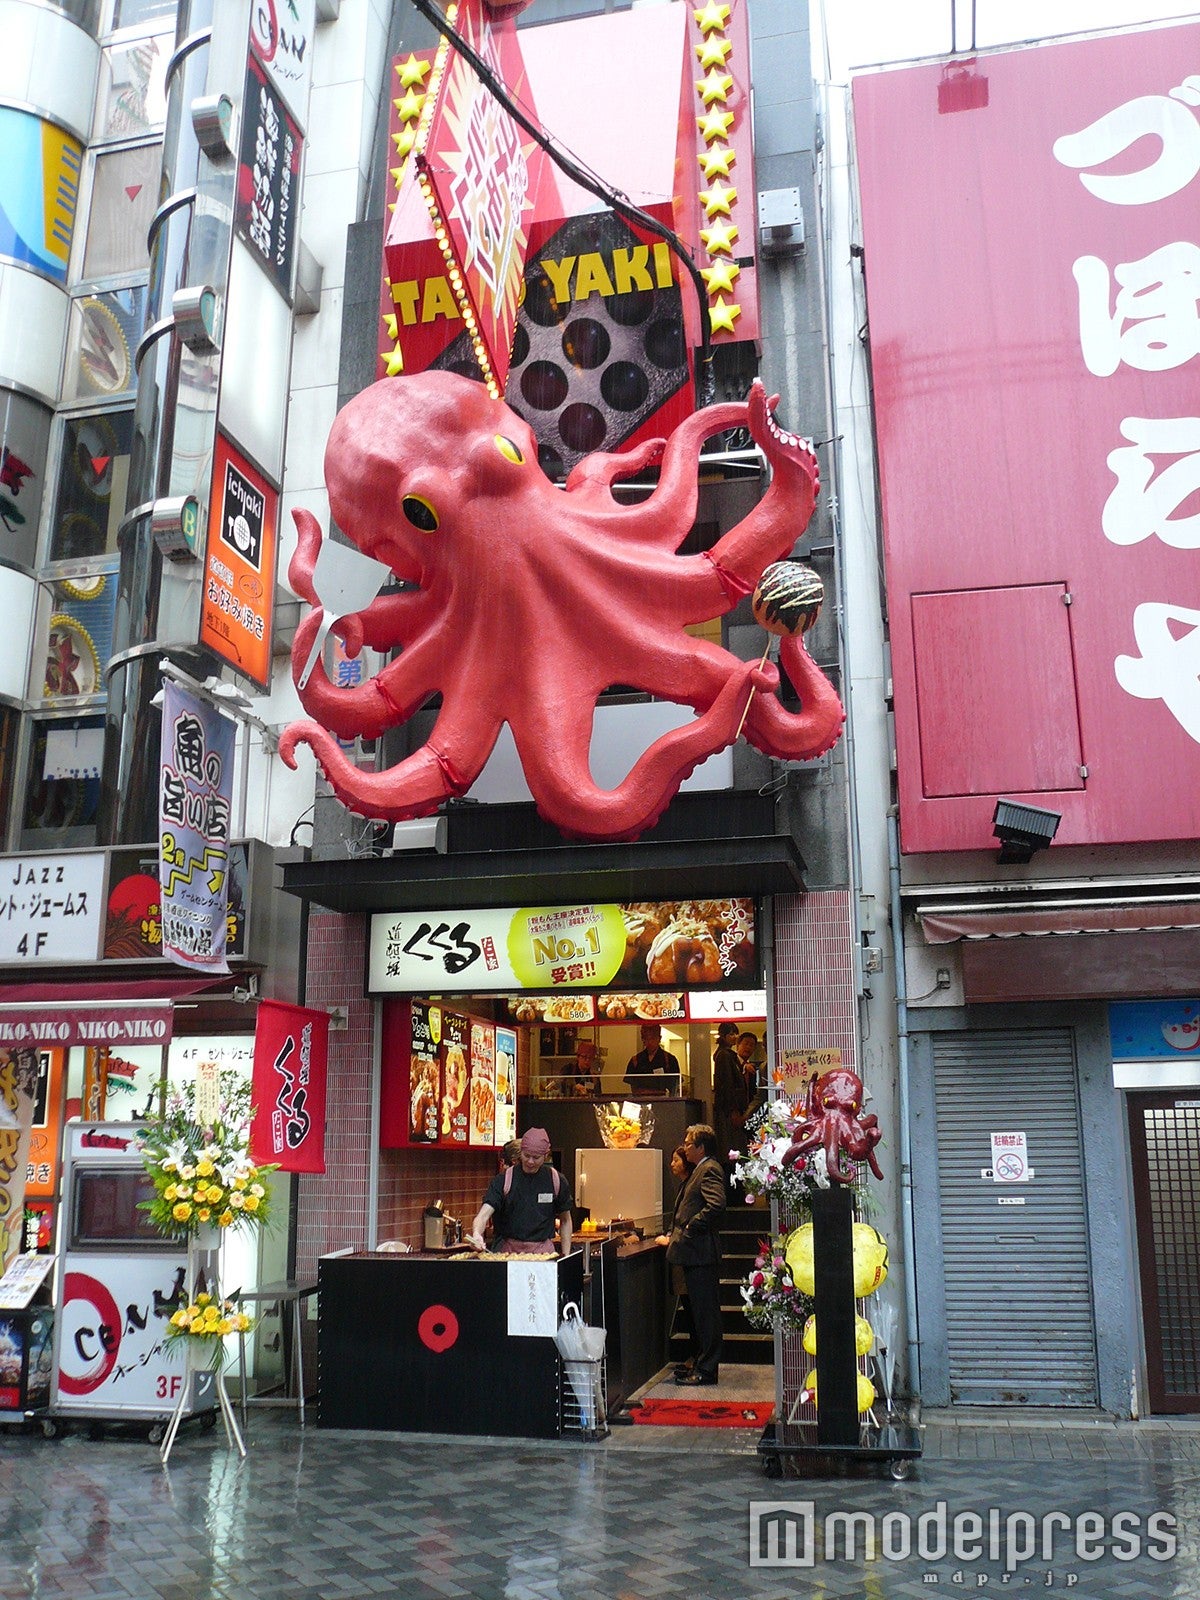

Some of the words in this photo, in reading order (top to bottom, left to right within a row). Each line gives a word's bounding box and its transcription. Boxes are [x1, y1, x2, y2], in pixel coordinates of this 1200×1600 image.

[540, 243, 674, 304] YAKI
[184, 508, 195, 537] B
[207, 577, 265, 641] お好み焼き
[16, 932, 48, 957] 4F
[402, 922, 481, 974] くくる
[532, 927, 600, 966] No.1
[550, 961, 596, 985] 受賞!!
[717, 1000, 744, 1013] 入口
[77, 1019, 167, 1040] NIKO-NIKO
[182, 1049, 198, 1060] 4F
[274, 1035, 311, 1149] くくる
[994, 1135, 1024, 1147] 駐輪禁止
[156, 1375, 183, 1399] 3F
